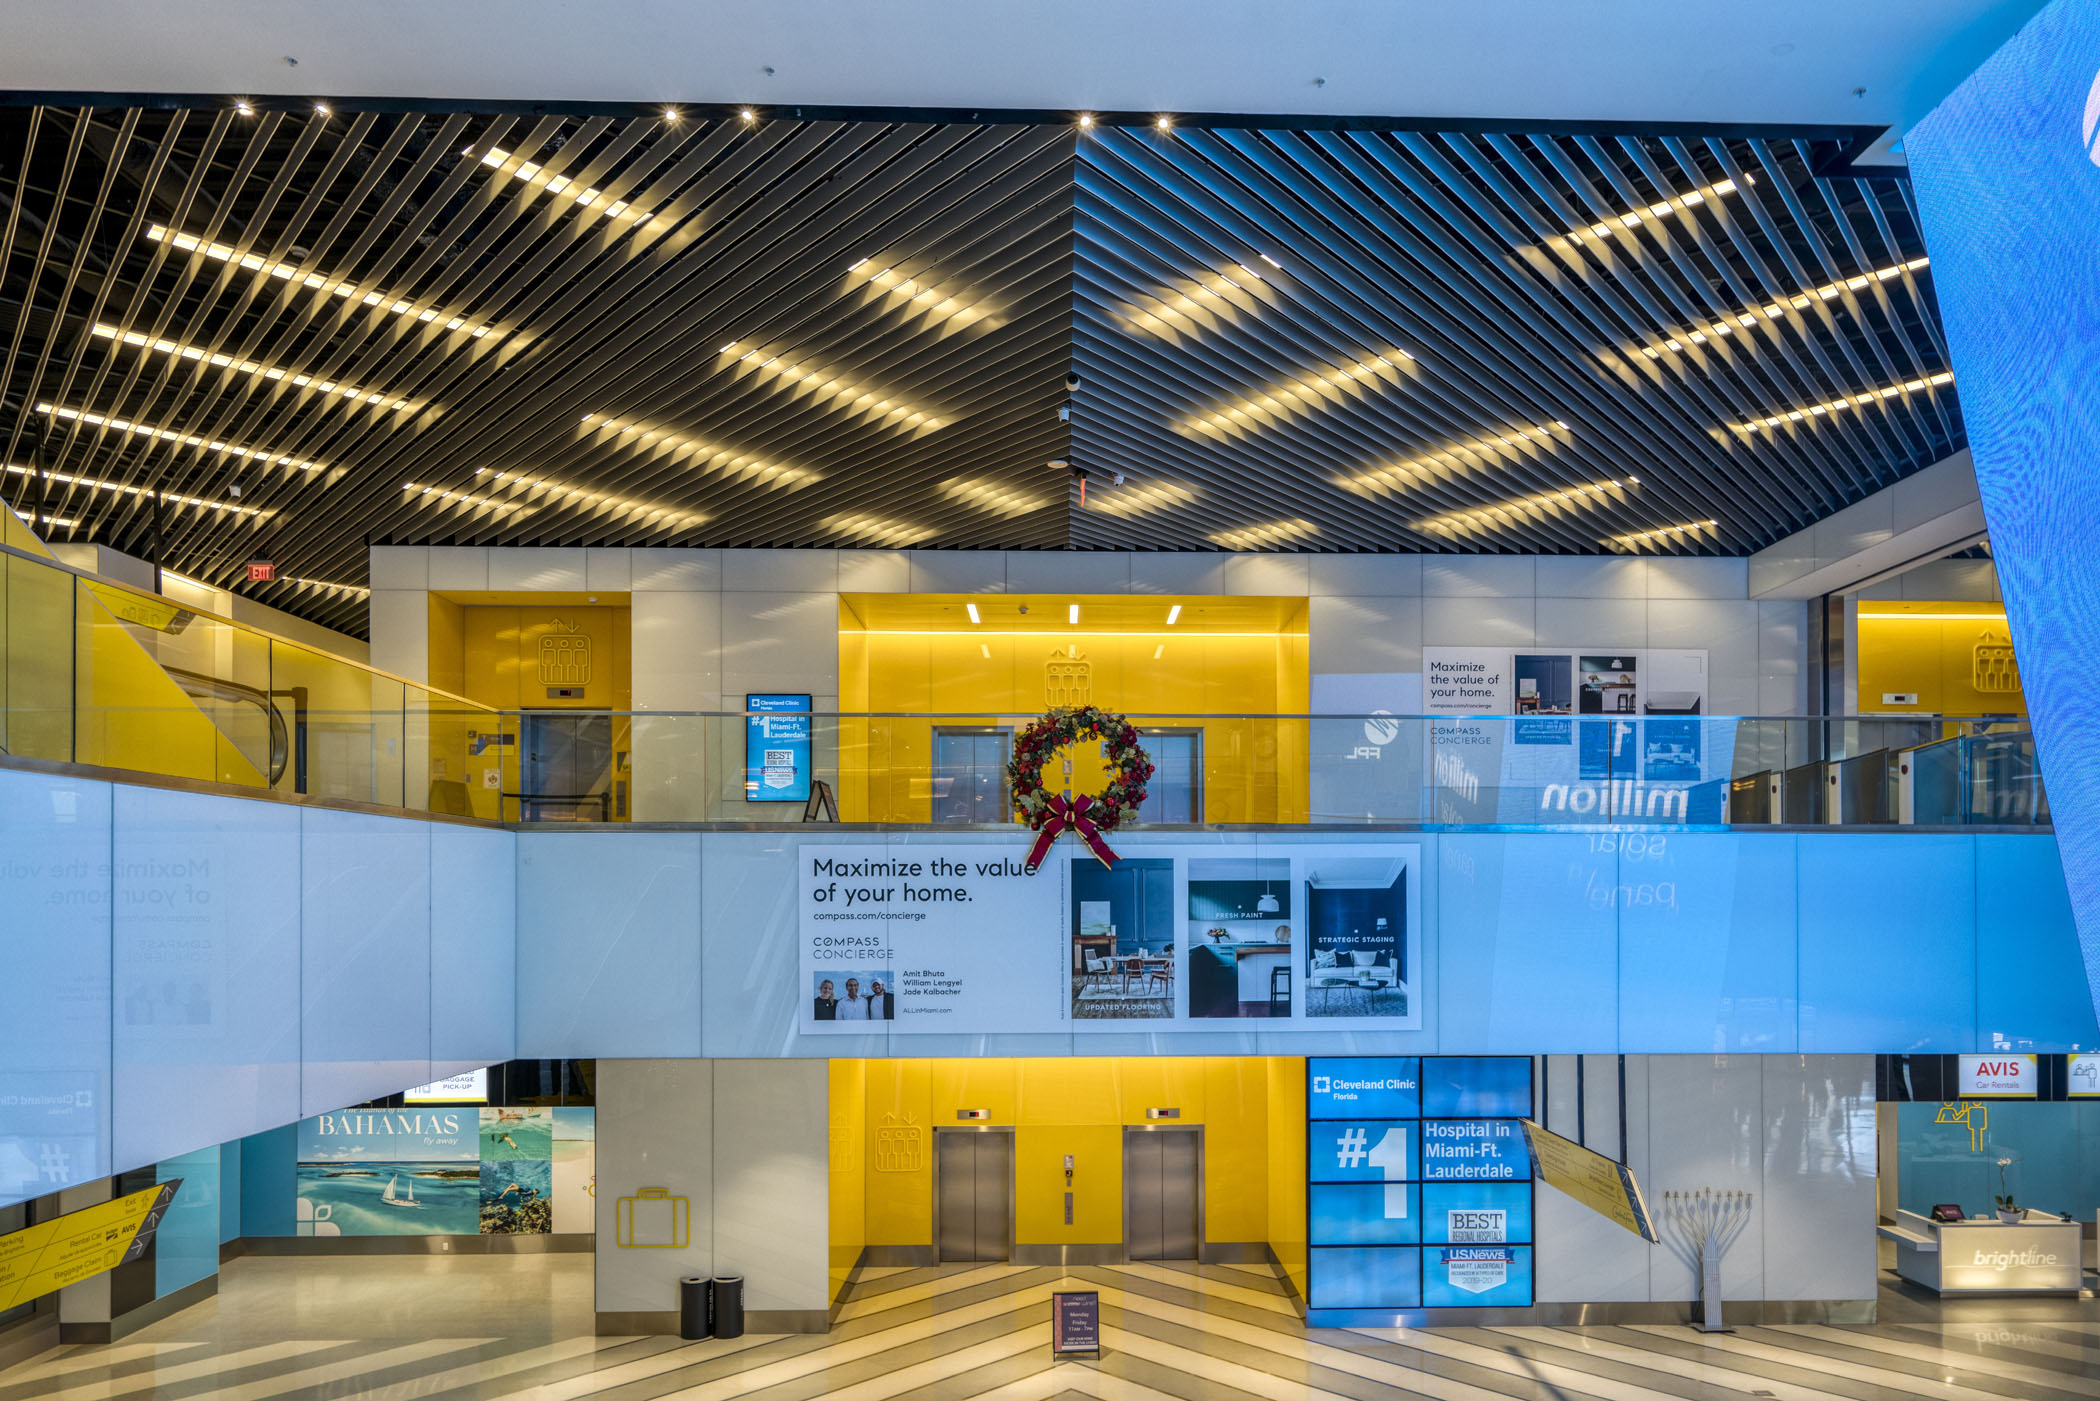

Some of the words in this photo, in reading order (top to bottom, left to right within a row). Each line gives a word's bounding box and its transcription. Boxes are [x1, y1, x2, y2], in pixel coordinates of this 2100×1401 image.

[252, 566, 270, 579] EXIT
[1431, 662, 1485, 672] Maximize
[1431, 674, 1449, 684] the
[1453, 674, 1484, 684] value
[1488, 674, 1499, 684] of
[1431, 689, 1456, 699] your
[1460, 687, 1495, 697] home.
[771, 715, 797, 723] Hospital
[752, 715, 770, 738] #1
[1431, 737, 1492, 745] CONCIERGE
[767, 751, 791, 760] BEST
[814, 857, 922, 877] Maximize
[931, 857, 968, 877] the
[976, 857, 1038, 877] value
[813, 883, 836, 902] of
[844, 887, 895, 906] your
[904, 883, 973, 902] home.
[813, 911, 926, 922] compass.com/concierge
[813, 937, 880, 947] COMPASS
[1318, 936, 1360, 944] STRATEGIC
[1362, 936, 1395, 944] STAGING
[813, 949, 894, 960] CONCIERGE
[933, 979, 963, 988] Lengyel
[903, 988, 921, 996] Jade
[923, 988, 961, 996] Kalbacher
[902, 1007, 953, 1015] ALLinMiami.com
[1085, 1003, 1120, 1011] UPDATED
[1122, 1003, 1161, 1011] FLOORING
[1976, 1062, 2020, 1077] AVIS
[1333, 1079, 1384, 1090] Cleveland
[1386, 1079, 1416, 1090] Clinic
[1992, 1081, 2020, 1089] Rentals
[1333, 1093, 1358, 1101] Florida
[319, 1114, 460, 1135] BAHAMAS
[1426, 1123, 1490, 1140] Hospital
[1496, 1123, 1510, 1137] in
[423, 1137, 434, 1145] fly
[1426, 1143, 1502, 1158] Miami-Ft.
[1337, 1127, 1407, 1219] #1
[1426, 1164, 1514, 1179] Lauderdale
[1452, 1213, 1503, 1230] BEST
[121, 1223, 137, 1234] AVIS
[69, 1236, 90, 1248] Rental
[91, 1232, 102, 1241] Car
[1453, 1231, 1475, 1242] REGIONAL
[1477, 1231, 1503, 1242] HOSPITALS
[1973, 1244, 2057, 1271] brightline
[54, 1264, 84, 1280] Baggage
[84, 1257, 102, 1267] Claim
